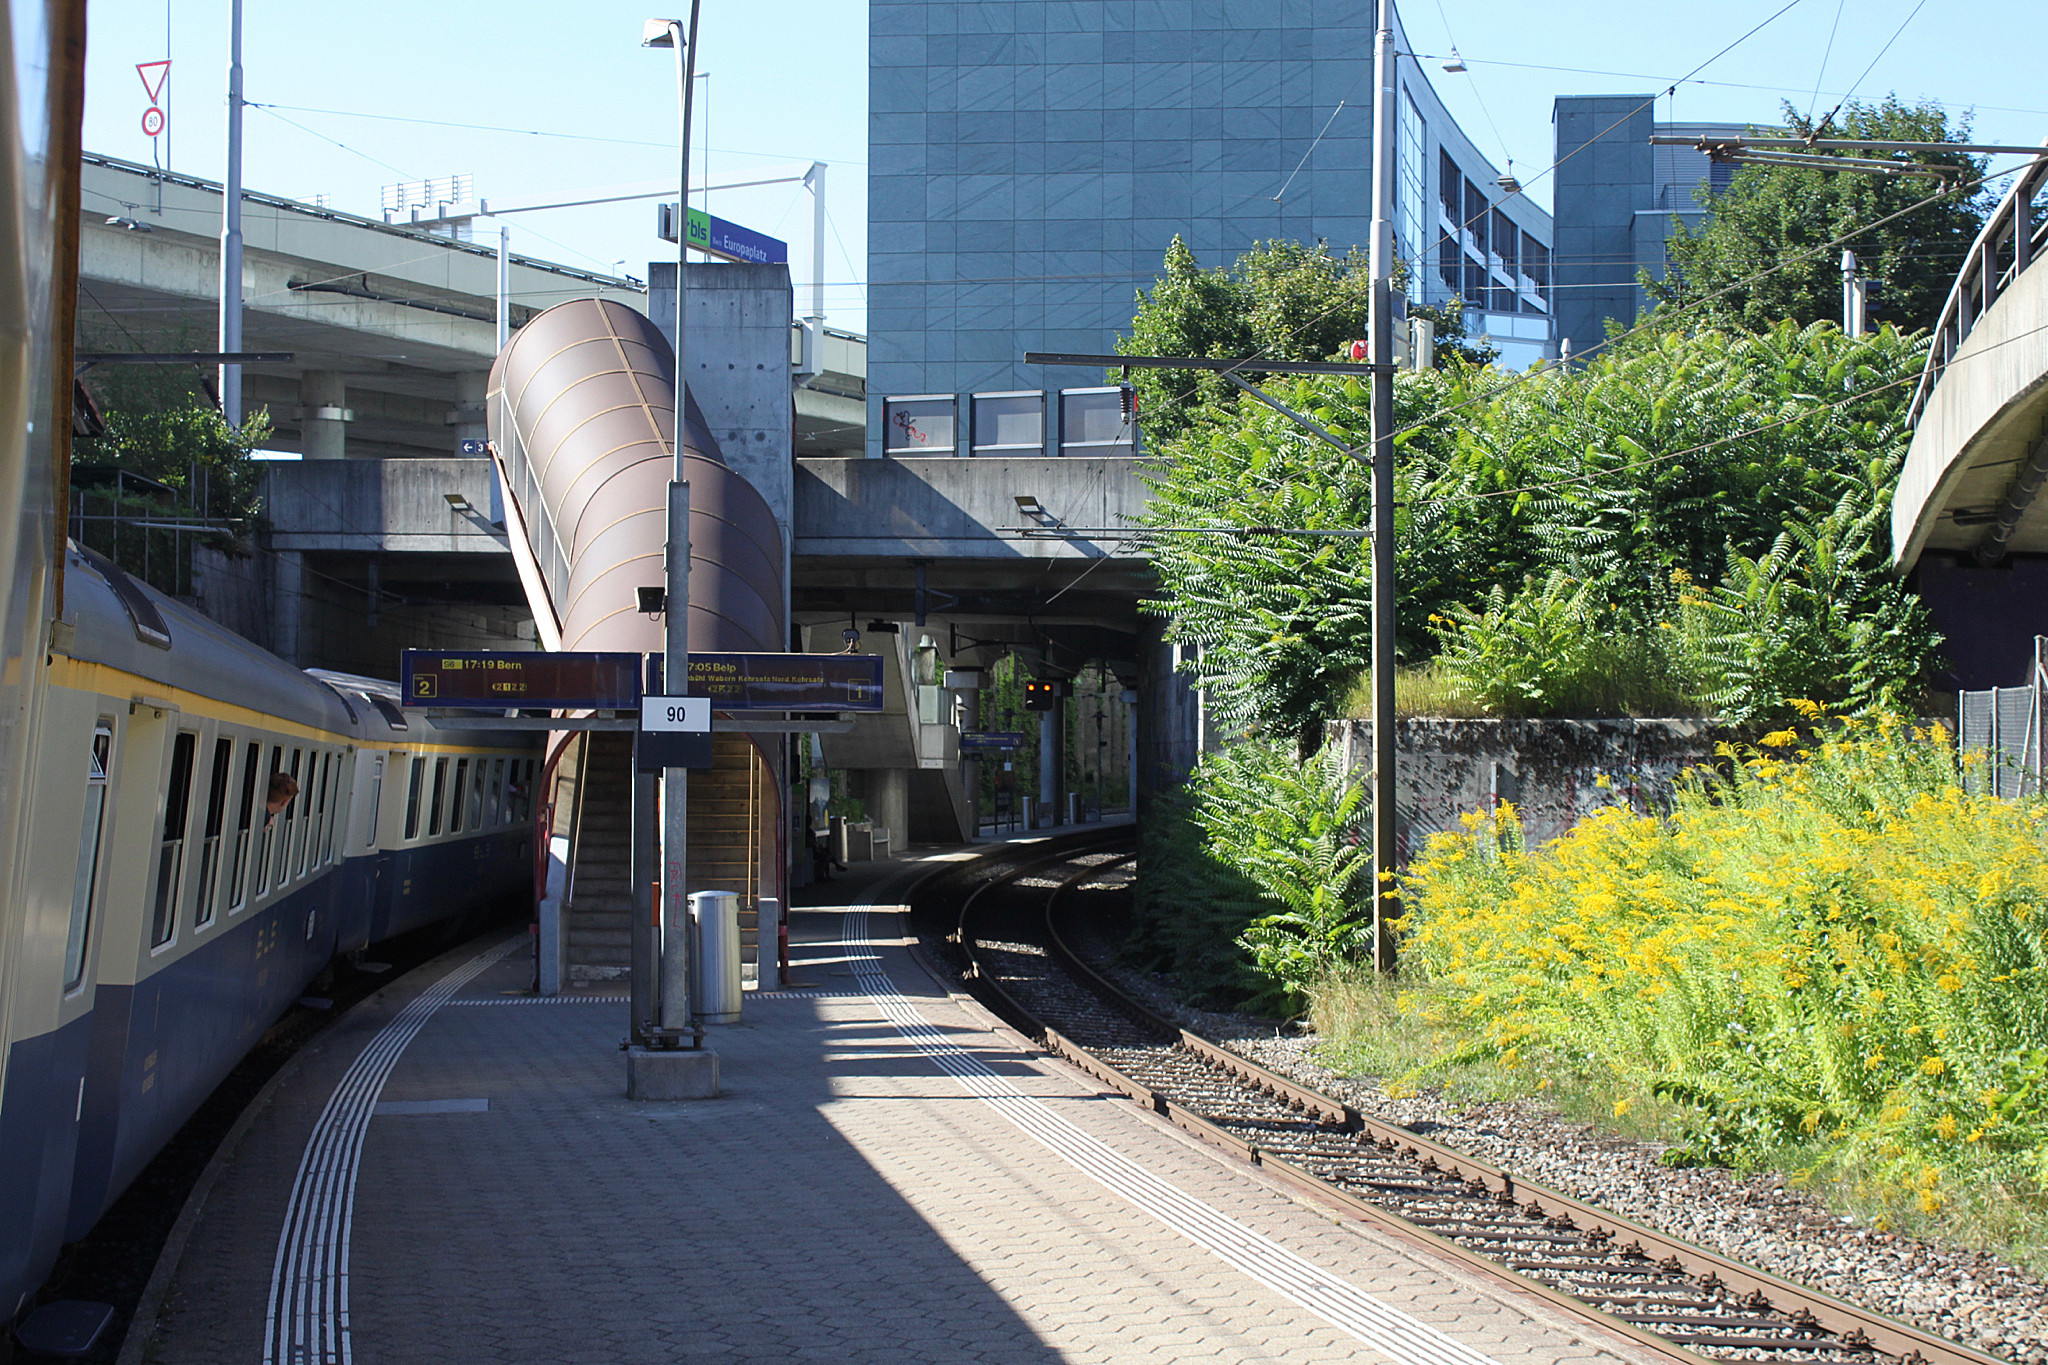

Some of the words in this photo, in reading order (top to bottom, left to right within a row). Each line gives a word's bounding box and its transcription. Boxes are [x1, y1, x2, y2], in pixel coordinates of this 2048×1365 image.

[148, 116, 158, 127] 80
[690, 219, 707, 241] bls
[723, 235, 768, 262] Europaplatz
[478, 443, 484, 452] 3
[464, 660, 495, 669] 17:19
[497, 660, 522, 669] Bern
[688, 662, 711, 672] 7:05
[713, 662, 737, 673] Belp
[419, 681, 430, 695] 2
[856, 686, 862, 699] 1
[666, 706, 686, 722] 90
